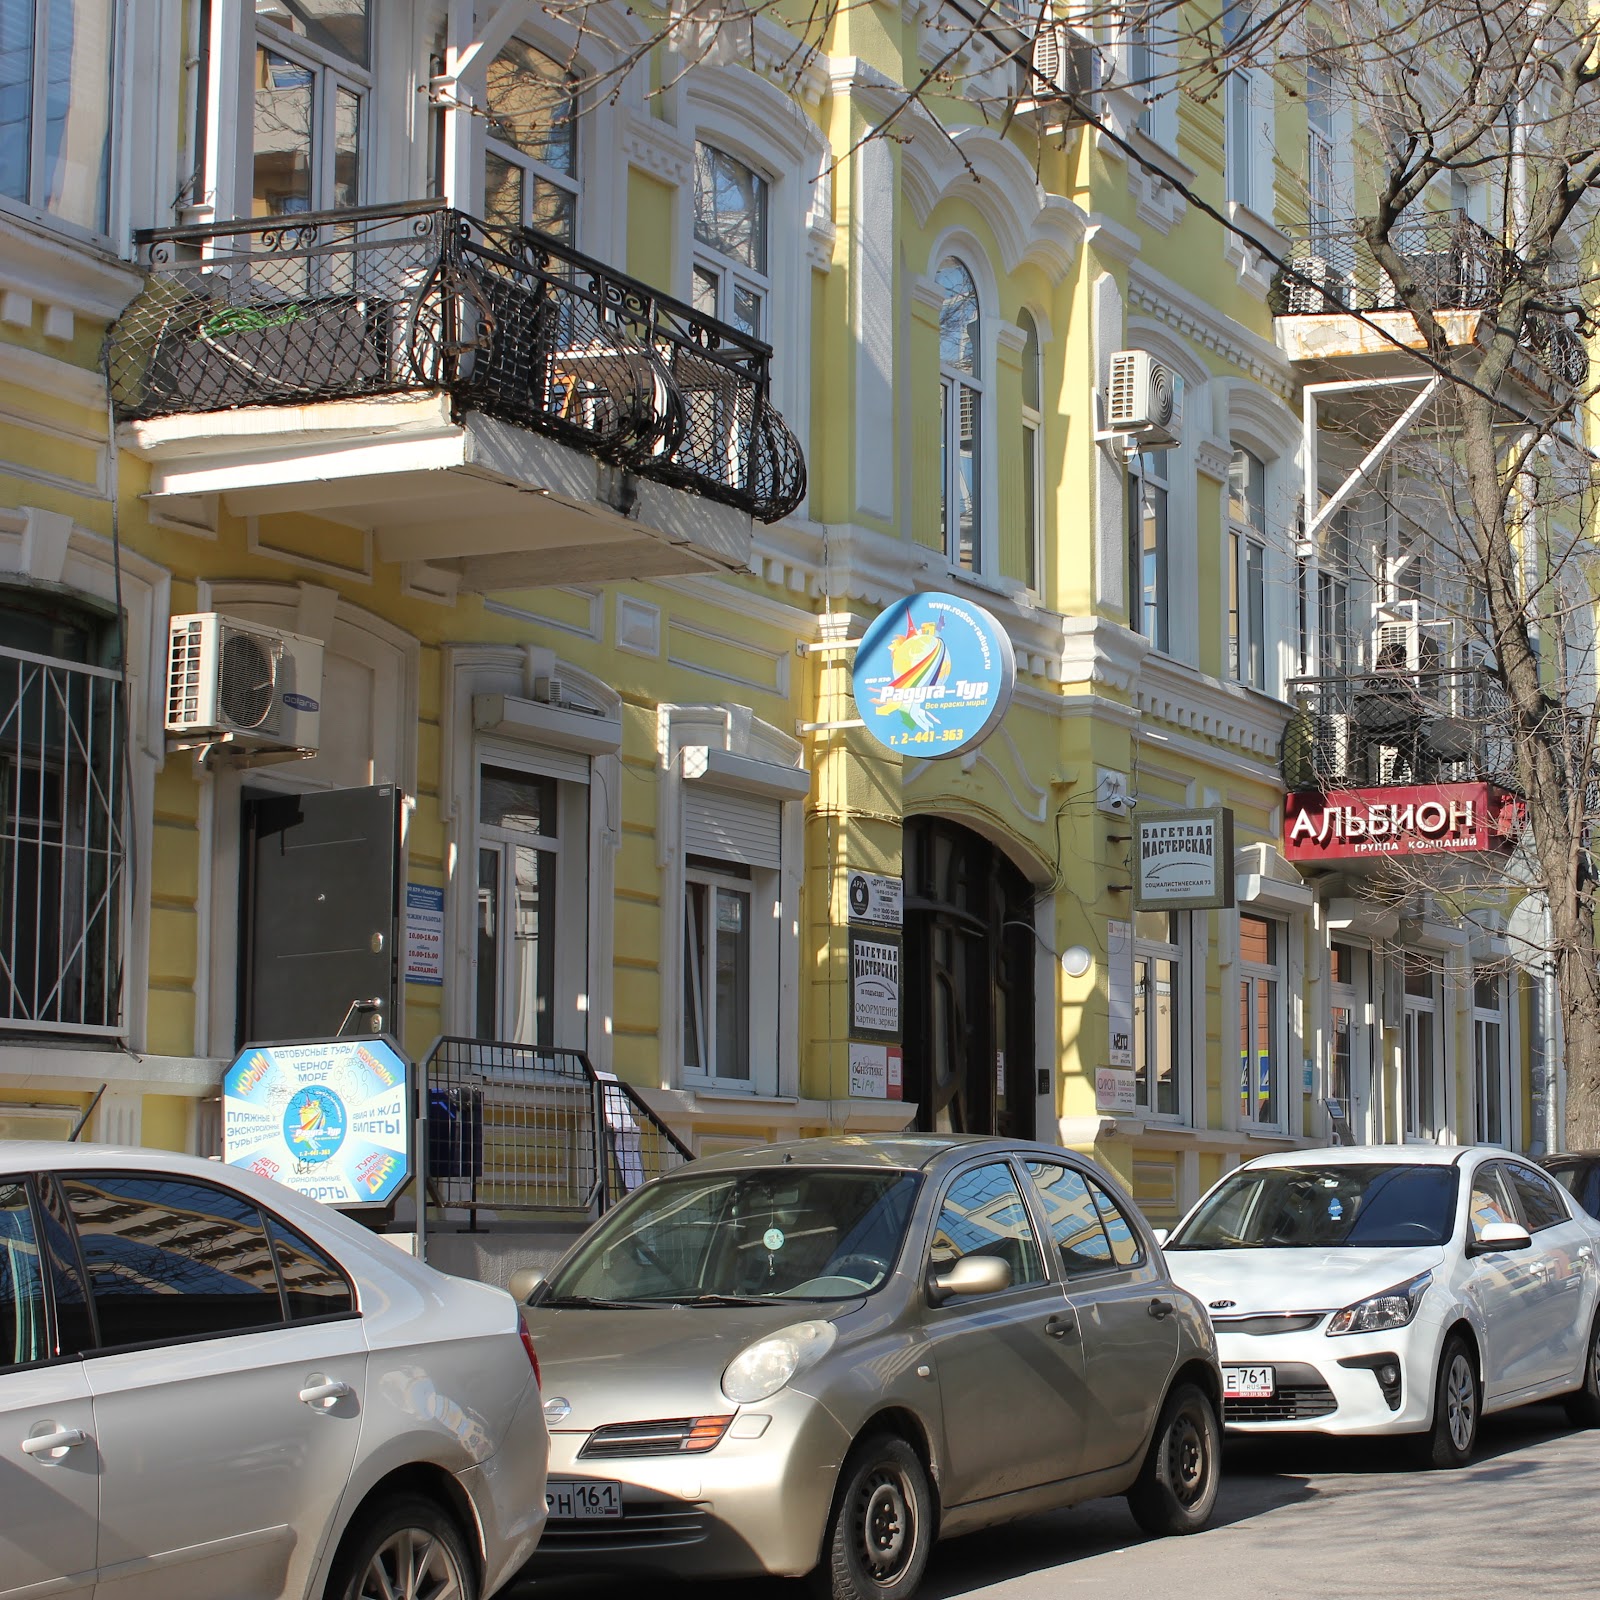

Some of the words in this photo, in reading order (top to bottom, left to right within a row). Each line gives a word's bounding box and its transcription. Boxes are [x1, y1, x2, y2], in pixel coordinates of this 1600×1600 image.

[928, 602, 991, 670] www.rostov-raduga.ru
[880, 680, 989, 704] Радуга-Тур
[284, 694, 318, 710] polaris
[940, 701, 965, 709] краски
[966, 698, 988, 708] мира!
[901, 729, 964, 745] 2-441-363
[1290, 800, 1474, 842] АЛЬБИОН
[1142, 825, 1213, 839] БАГЕТНАЯ
[1142, 838, 1213, 860] МАСТЕРСКАЯ
[1354, 841, 1399, 853] ГРУППА
[1408, 836, 1478, 850] КОМПАНИЙ
[1145, 881, 1203, 889] СОЦИАЛИСТИЧЕСКАЯ
[855, 944, 898, 962] БАГЕТНАЯ
[855, 958, 898, 985] МАСТЕРСКАЯ
[856, 1002, 898, 1018] ОФОРМЛЕНИЕ
[878, 1019, 897, 1028] зеркал
[274, 1046, 328, 1059] АВТОБУСНЫЕ
[331, 1045, 354, 1054] ТУРЫ
[232, 1051, 271, 1097] КРЫМ
[293, 1060, 334, 1072] ЧЕРНОЕ
[356, 1046, 398, 1087] АБХАЗИЯ
[298, 1072, 328, 1082] МОРЕ
[228, 1111, 270, 1123] ПЛЯЖНЫЕ
[352, 1110, 368, 1120] АВИА
[369, 1108, 375, 1118] И
[378, 1102, 400, 1116] Ж/Д
[227, 1124, 280, 1137] ЭКСКУРСИОННЫЕ
[352, 1119, 400, 1134] БИЛЕТЫ
[228, 1138, 253, 1150] ТУРЫ
[258, 1157, 280, 1173] АВТО
[355, 1152, 380, 1170] ТУРЫ
[287, 1175, 342, 1184] ГОРНОЛЫЖНЫЕ
[366, 1156, 401, 1194] ДНЯ
[1240, 1369, 1267, 1384] 761
[576, 1486, 613, 1507] 161
[585, 1506, 604, 1515] RUS
